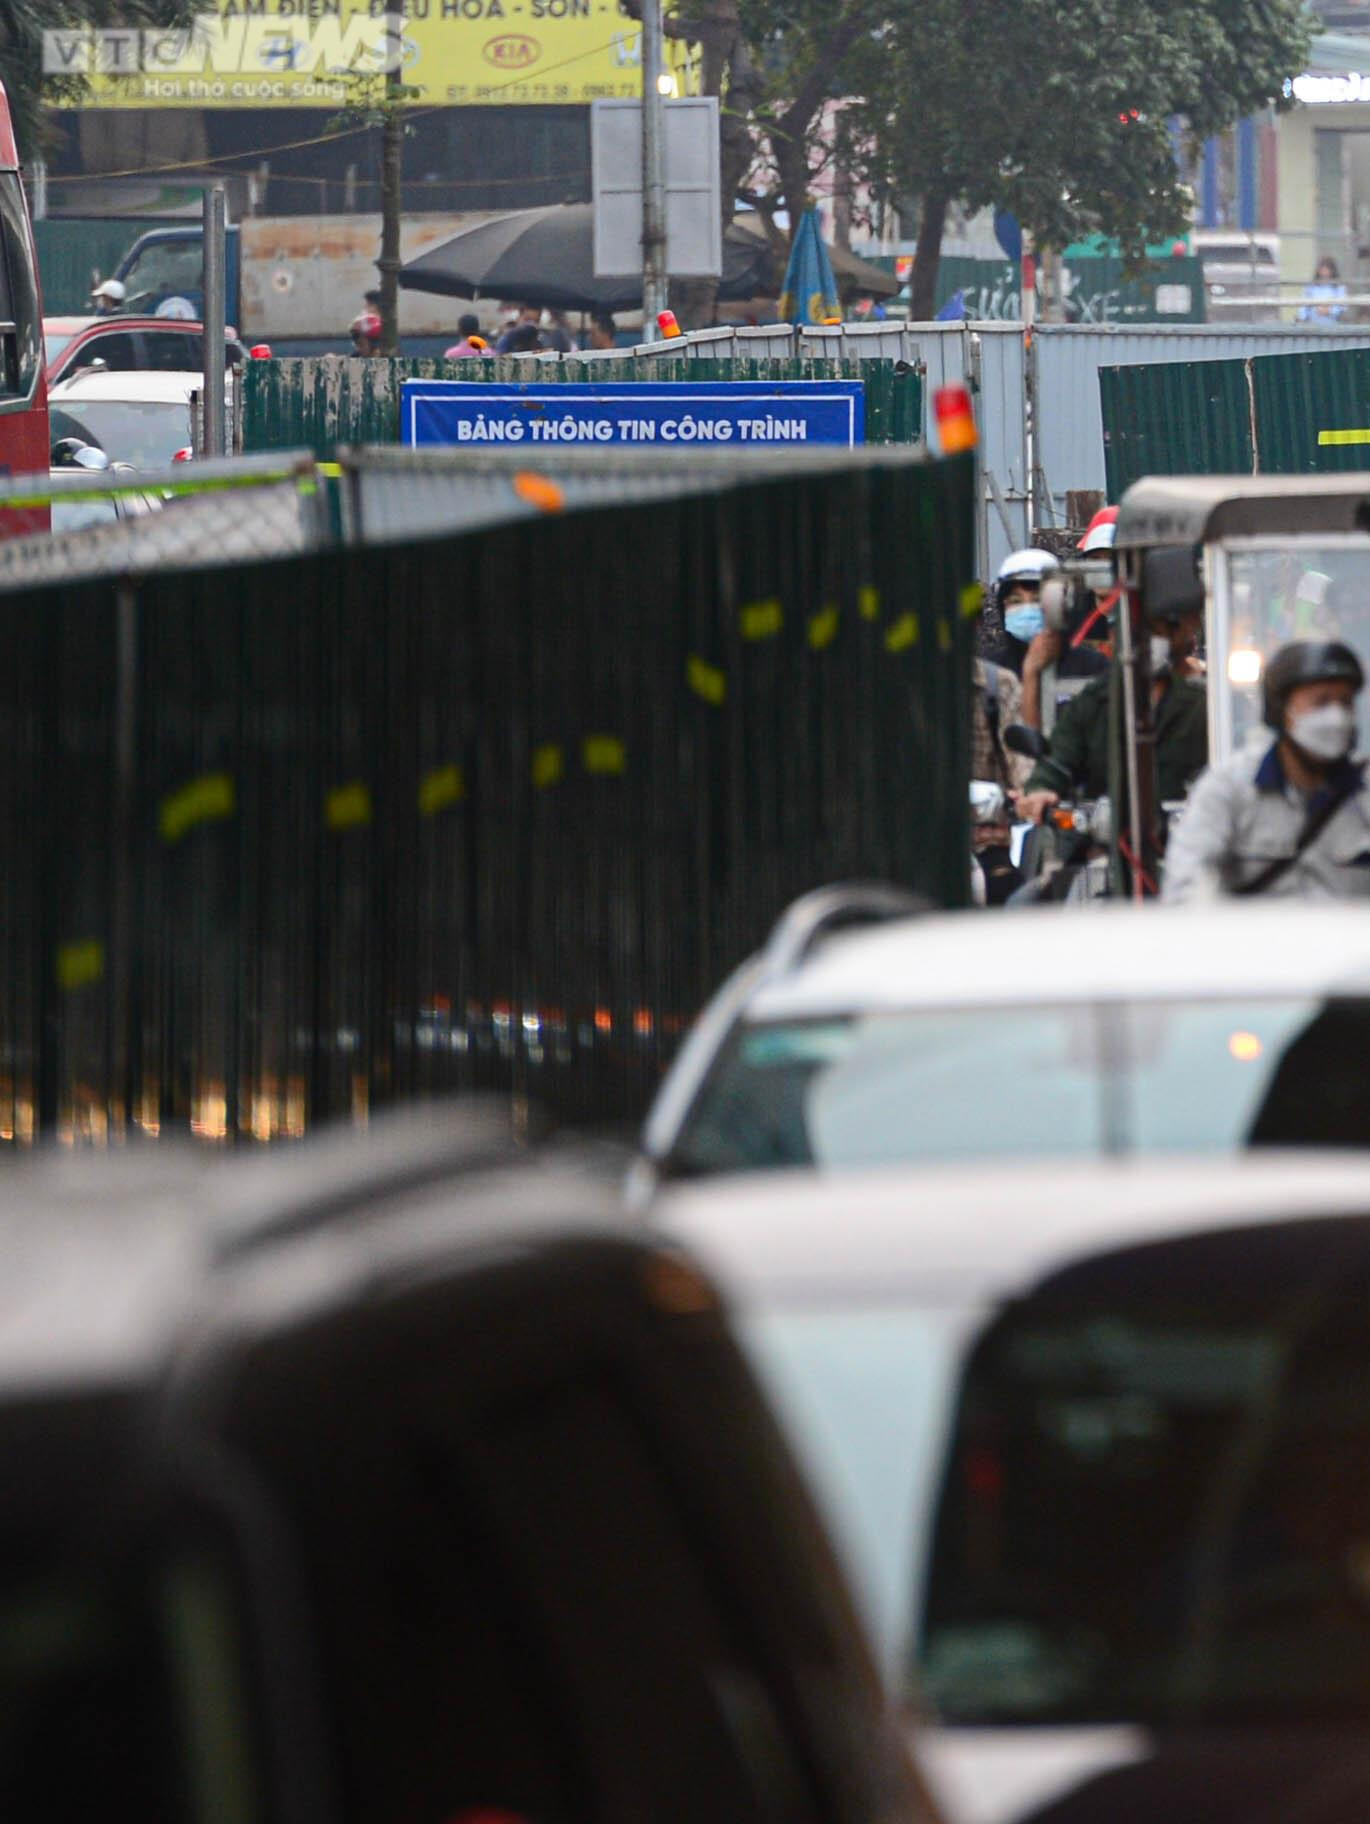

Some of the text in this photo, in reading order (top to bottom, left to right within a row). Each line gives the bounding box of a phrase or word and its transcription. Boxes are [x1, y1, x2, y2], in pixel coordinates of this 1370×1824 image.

[492, 45, 532, 60] KIA
[457, 413, 807, 441] BẢNG THÔNG TIN CÔNG TRÌNH
